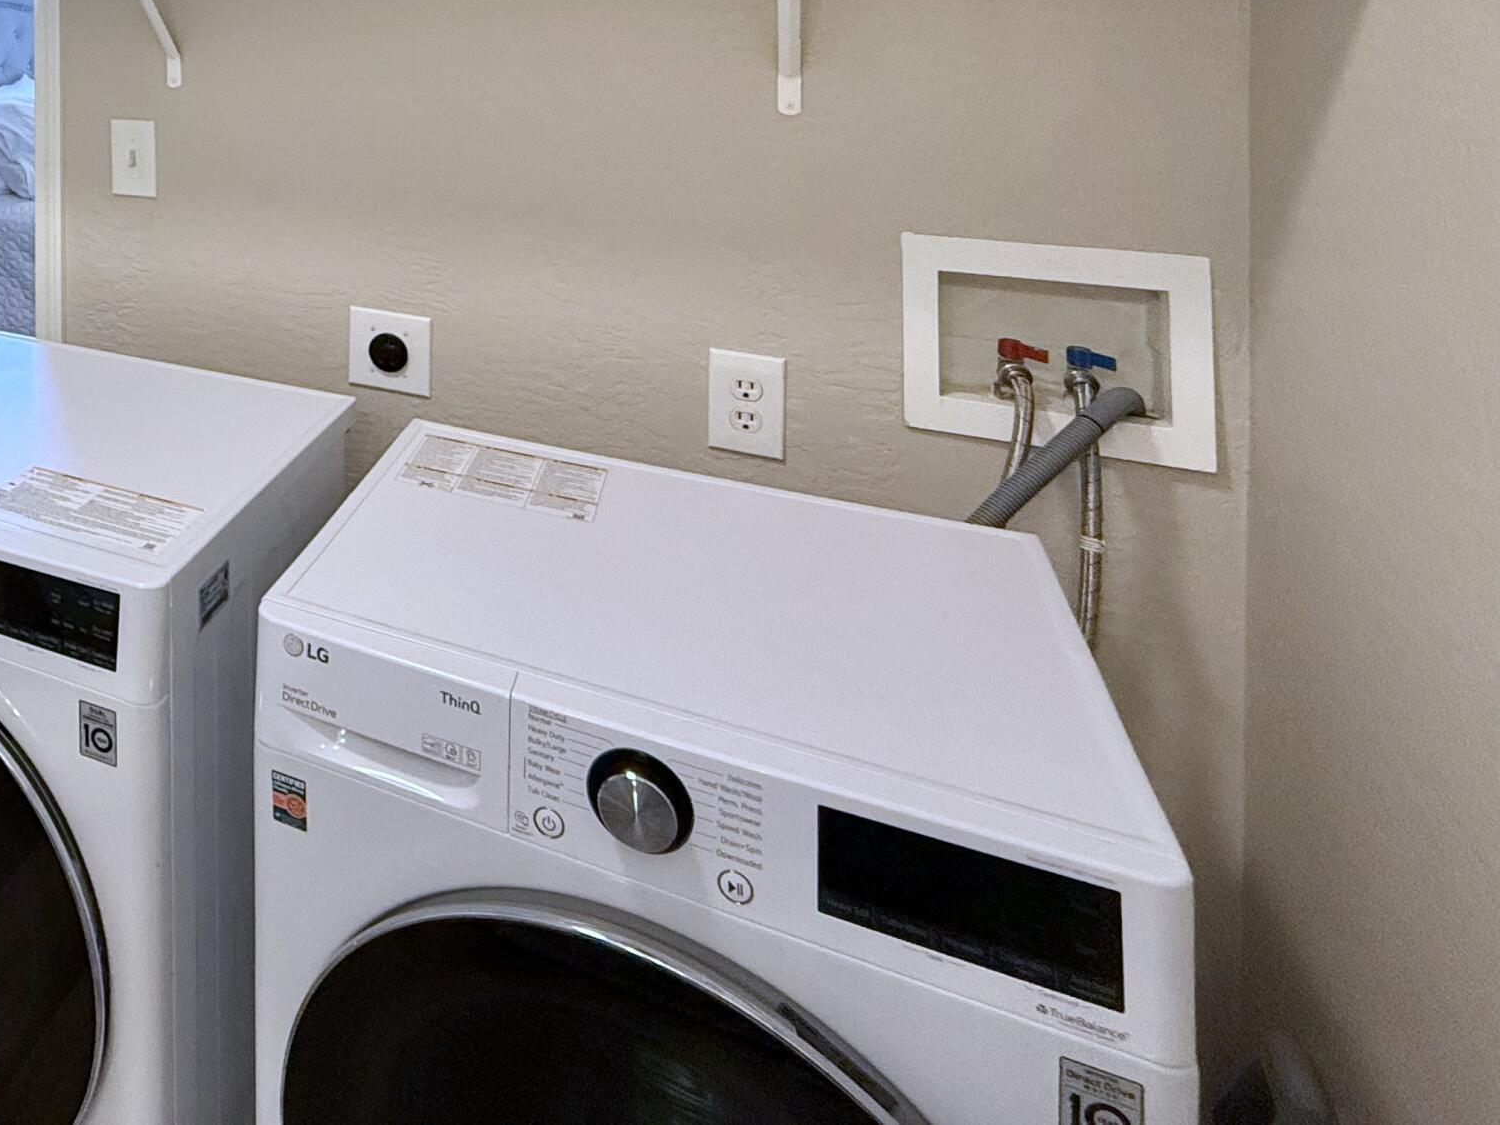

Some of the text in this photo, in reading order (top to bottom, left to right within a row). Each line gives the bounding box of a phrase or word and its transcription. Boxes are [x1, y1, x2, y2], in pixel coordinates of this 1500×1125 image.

[307, 643, 330, 664] LG
[440, 691, 481, 715] ThinQ
[84, 723, 113, 754] 10
